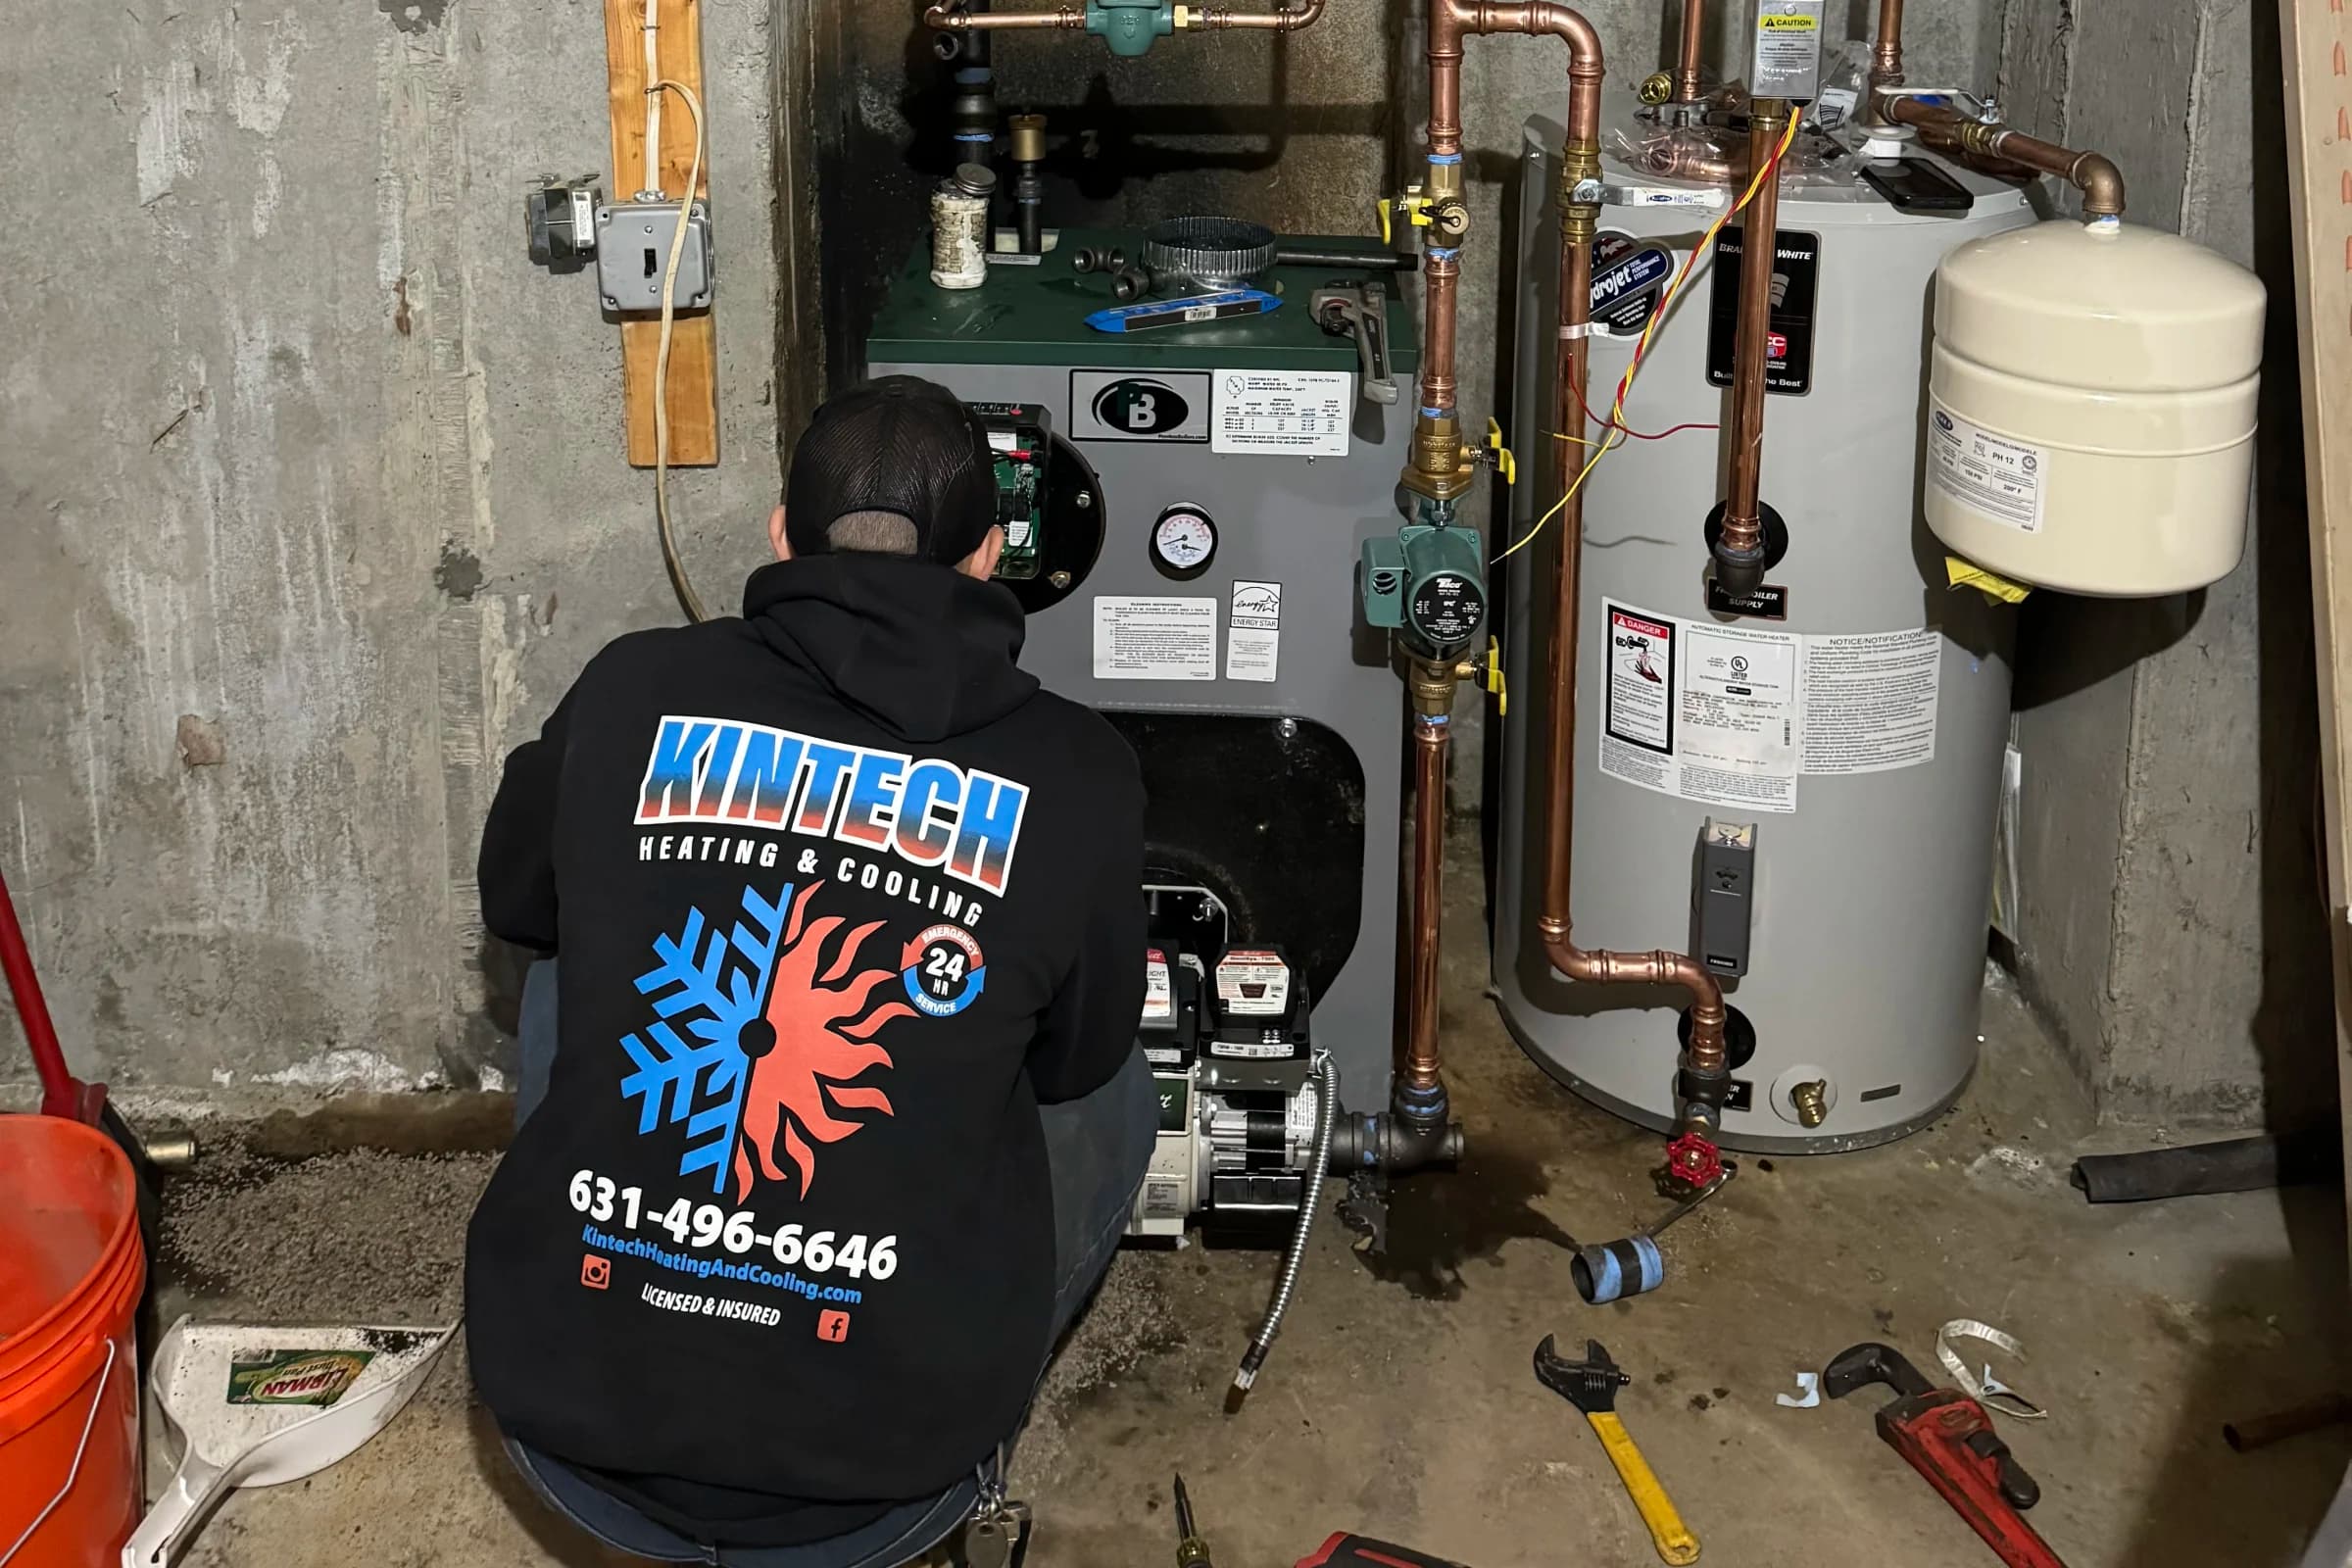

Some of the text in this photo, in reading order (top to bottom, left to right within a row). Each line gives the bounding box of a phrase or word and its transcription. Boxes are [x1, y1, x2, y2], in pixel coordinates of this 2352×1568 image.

[1776, 19, 1811, 27] CAUTION
[1777, 249, 1812, 261] WHITE
[1714, 370, 1734, 380] Built
[1779, 378, 1801, 387] Best
[1992, 452, 2015, 465] PH 12
[1728, 598, 1764, 609] SUPPLY
[1233, 617, 1258, 626] ENERGY
[1627, 620, 1662, 636] DANGER
[1690, 623, 1721, 634] AUTOMATIC
[1722, 628, 1748, 638] STORAGE
[1829, 632, 1922, 646] NOTICE/NOTIFICATION
[633, 713, 1030, 899] KINTECH
[639, 835, 983, 928] HEATING & COOLING
[921, 926, 979, 956] EMERGENCY
[925, 947, 965, 983] 24
[932, 978, 950, 997] HR
[915, 993, 957, 1014] SERVICE
[568, 1169, 898, 1280] 631-496-6646
[641, 1282, 781, 1327] LICENSED & INSURED
[281, 1365, 307, 1377] Pan
[260, 1367, 349, 1396] LIBMAN
